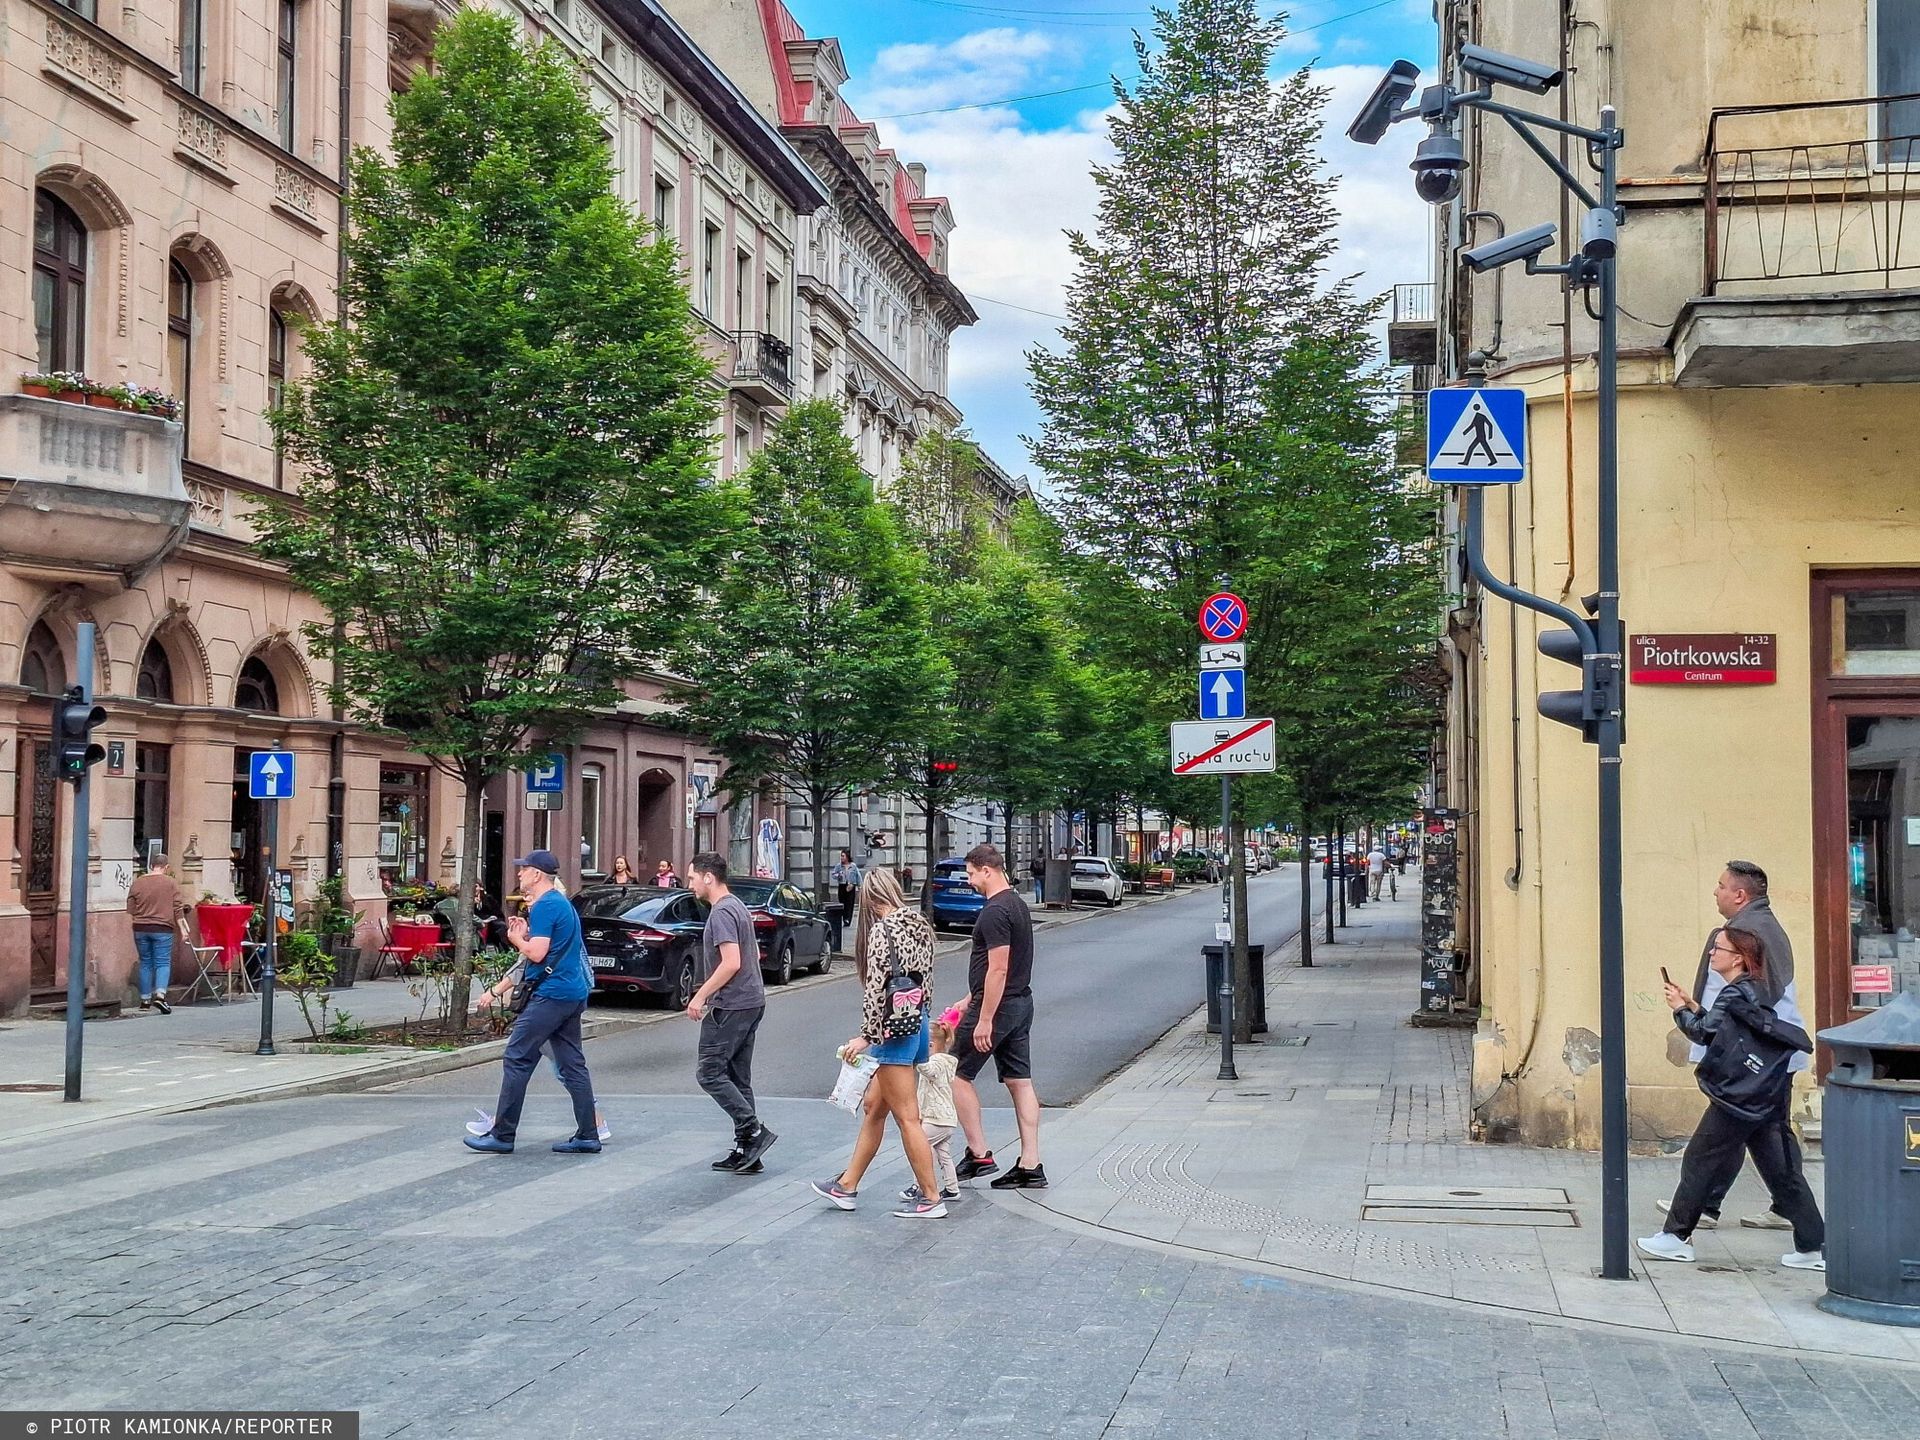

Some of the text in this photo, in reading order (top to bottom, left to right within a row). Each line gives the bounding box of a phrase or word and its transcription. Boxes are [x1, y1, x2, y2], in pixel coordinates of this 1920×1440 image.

[1636, 636, 1769, 645] ulica 14-32
[1643, 645, 1761, 665] Piotrkowska
[1684, 671, 1723, 681] Centrum
[1178, 751, 1222, 765] Sta
